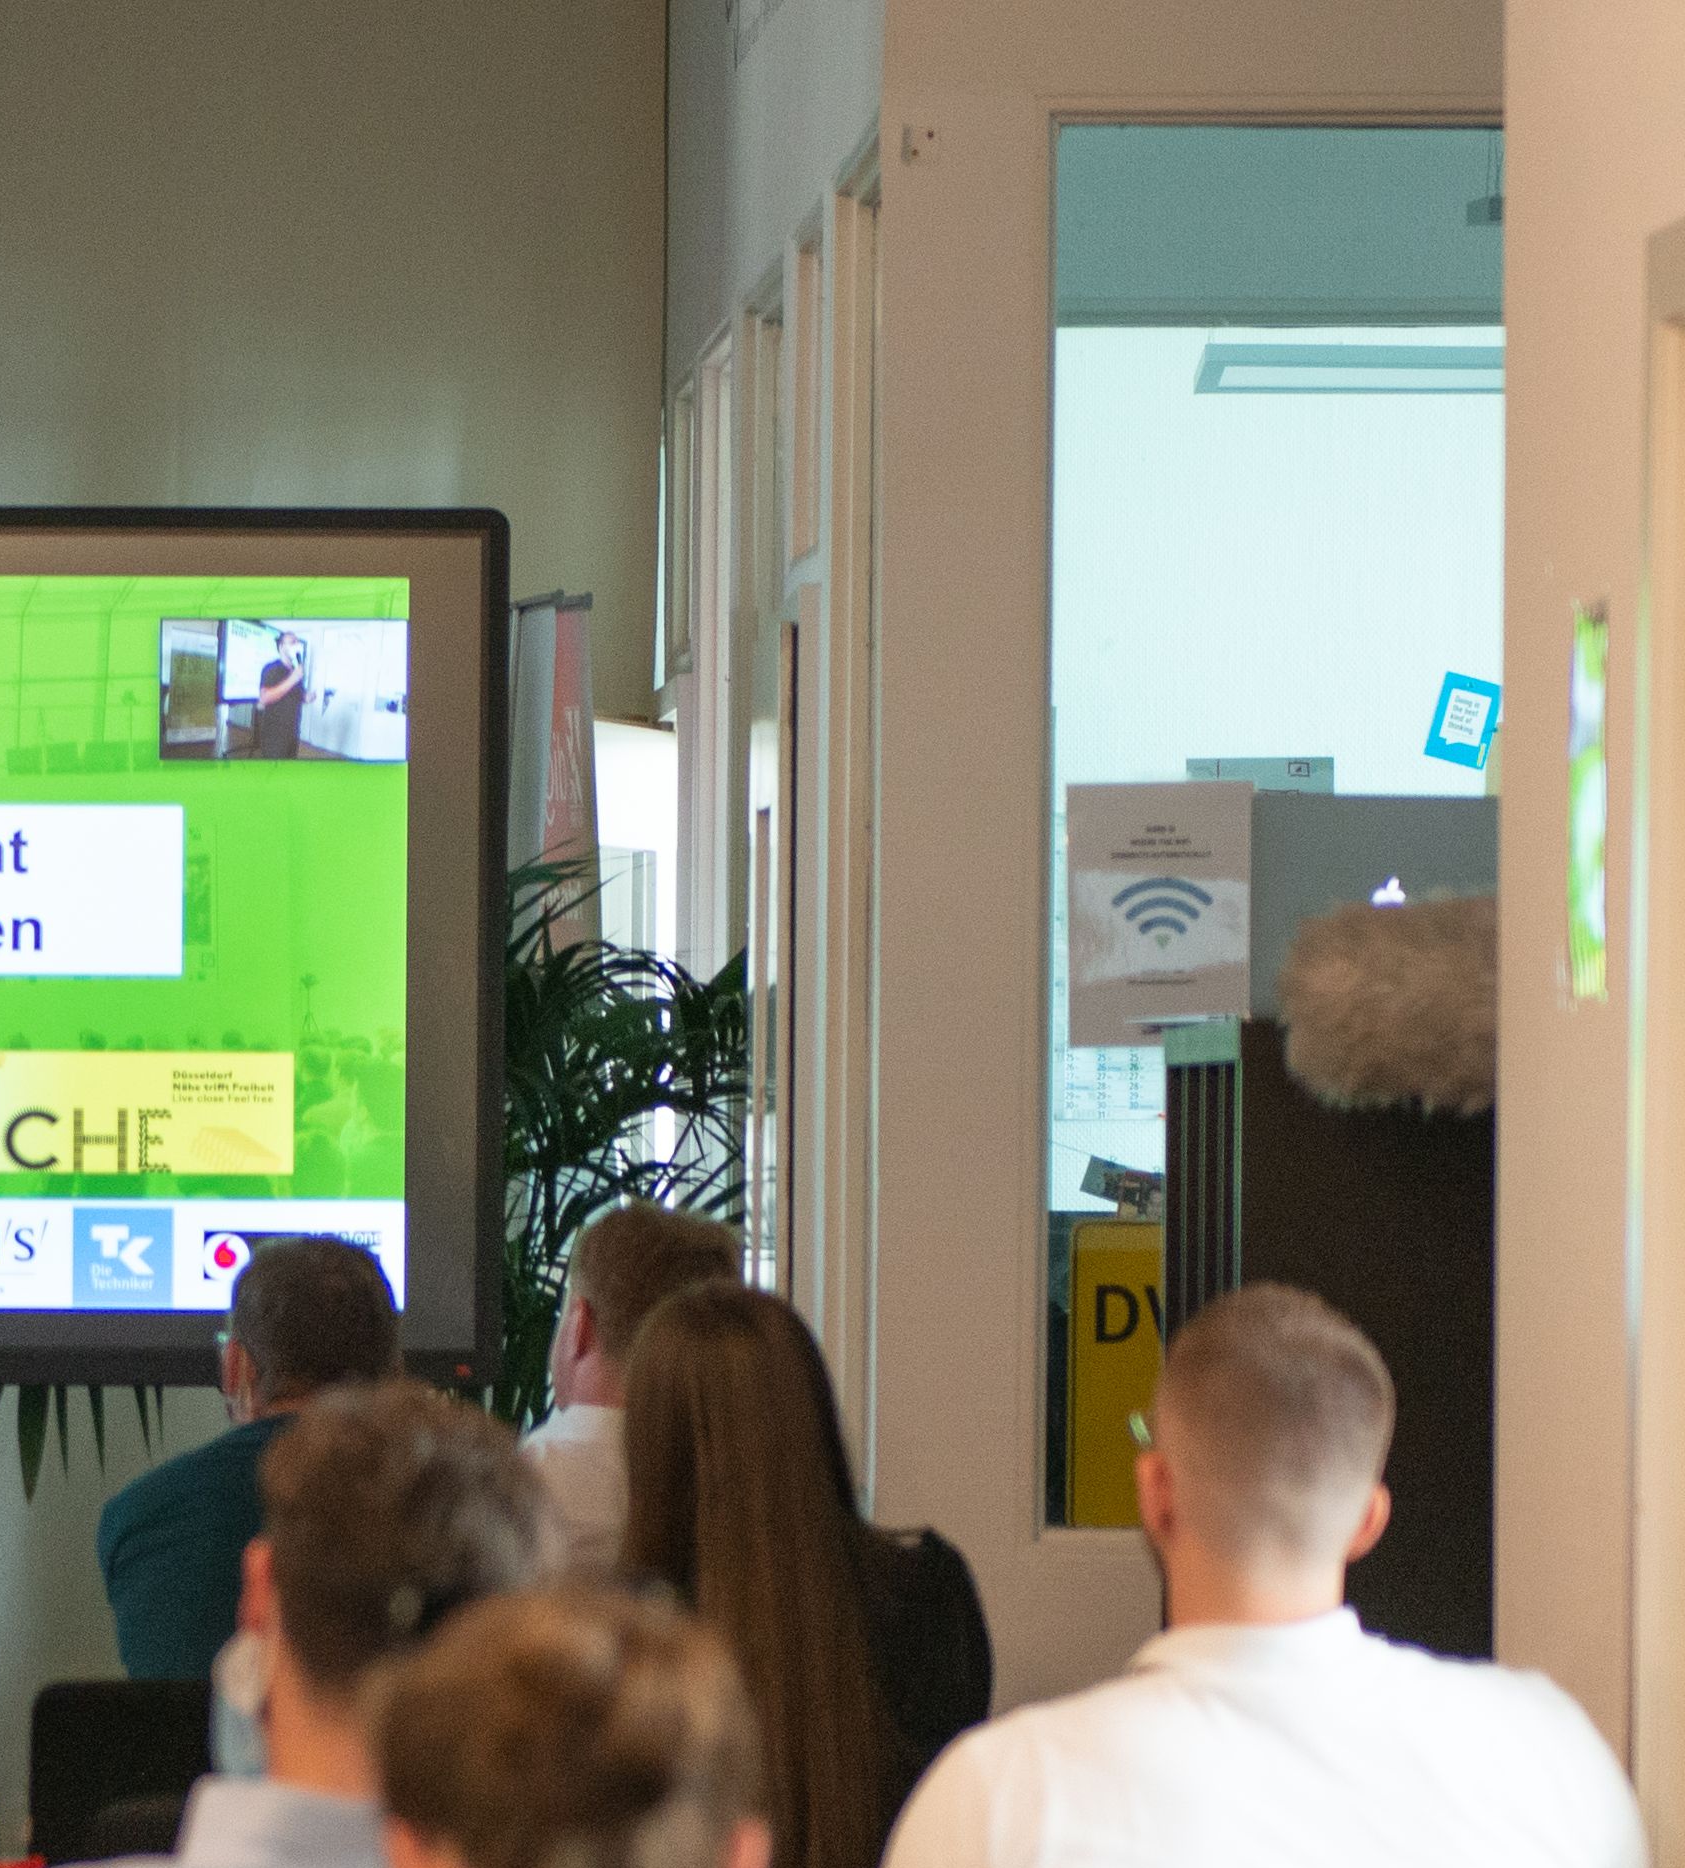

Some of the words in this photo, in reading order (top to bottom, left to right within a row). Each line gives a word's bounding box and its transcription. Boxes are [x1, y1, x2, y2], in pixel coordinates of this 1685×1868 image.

[173, 1070, 232, 1079] Düsseldorf
[91, 1224, 154, 1276] TK
[92, 1263, 112, 1276] Die
[92, 1277, 154, 1290] Techniker
